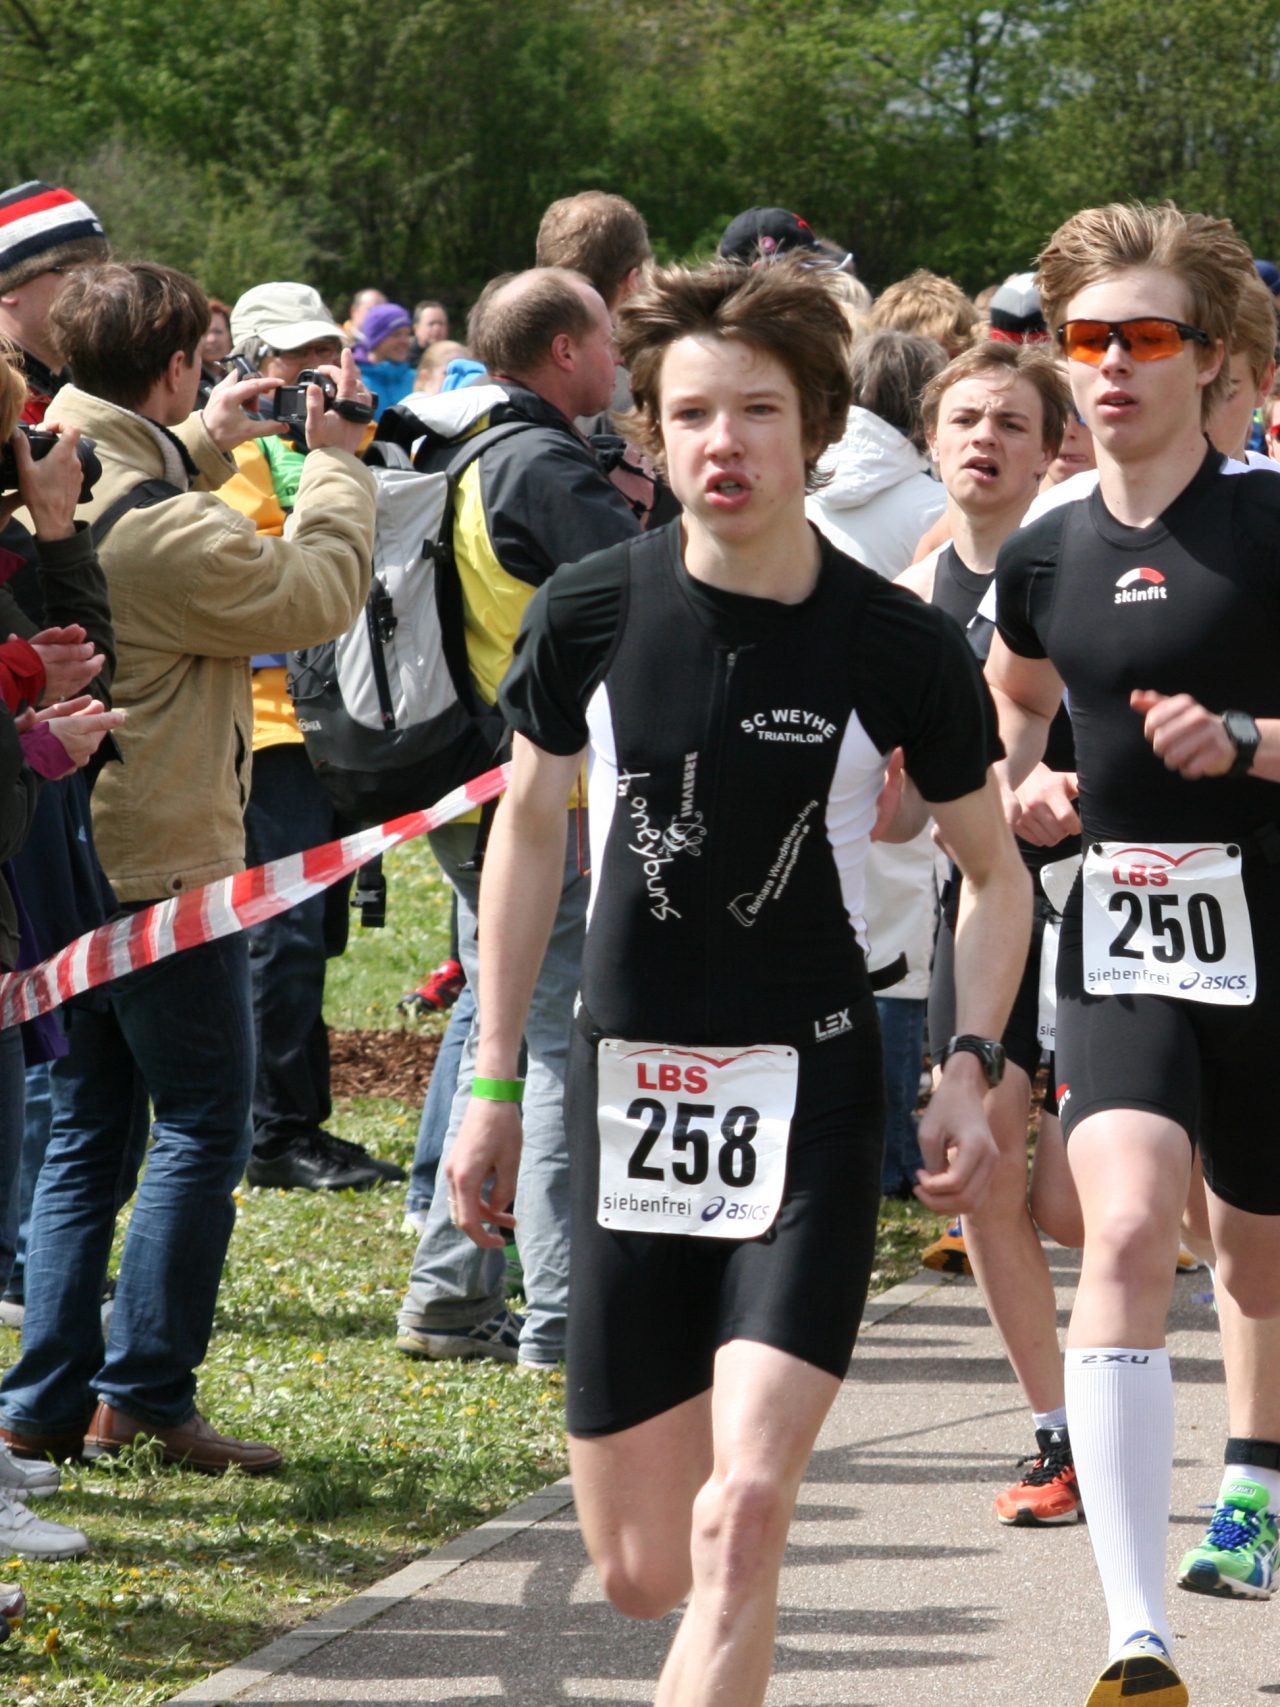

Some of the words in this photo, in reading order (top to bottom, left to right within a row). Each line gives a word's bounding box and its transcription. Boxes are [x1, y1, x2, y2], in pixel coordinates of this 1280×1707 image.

[1114, 586, 1167, 604] skinfit
[741, 712, 767, 733] SC
[771, 708, 837, 738] WEYHE
[757, 730, 824, 743] TRIATHLON
[1112, 865, 1169, 887] LBS
[746, 879, 775, 914] Barbara
[1109, 891, 1227, 963] 250
[1088, 967, 1170, 985] siebenfrei
[815, 1008, 851, 1039] LEX
[637, 1063, 708, 1094] LBS
[626, 1097, 760, 1188] 258
[603, 1192, 692, 1216] siebenfrei
